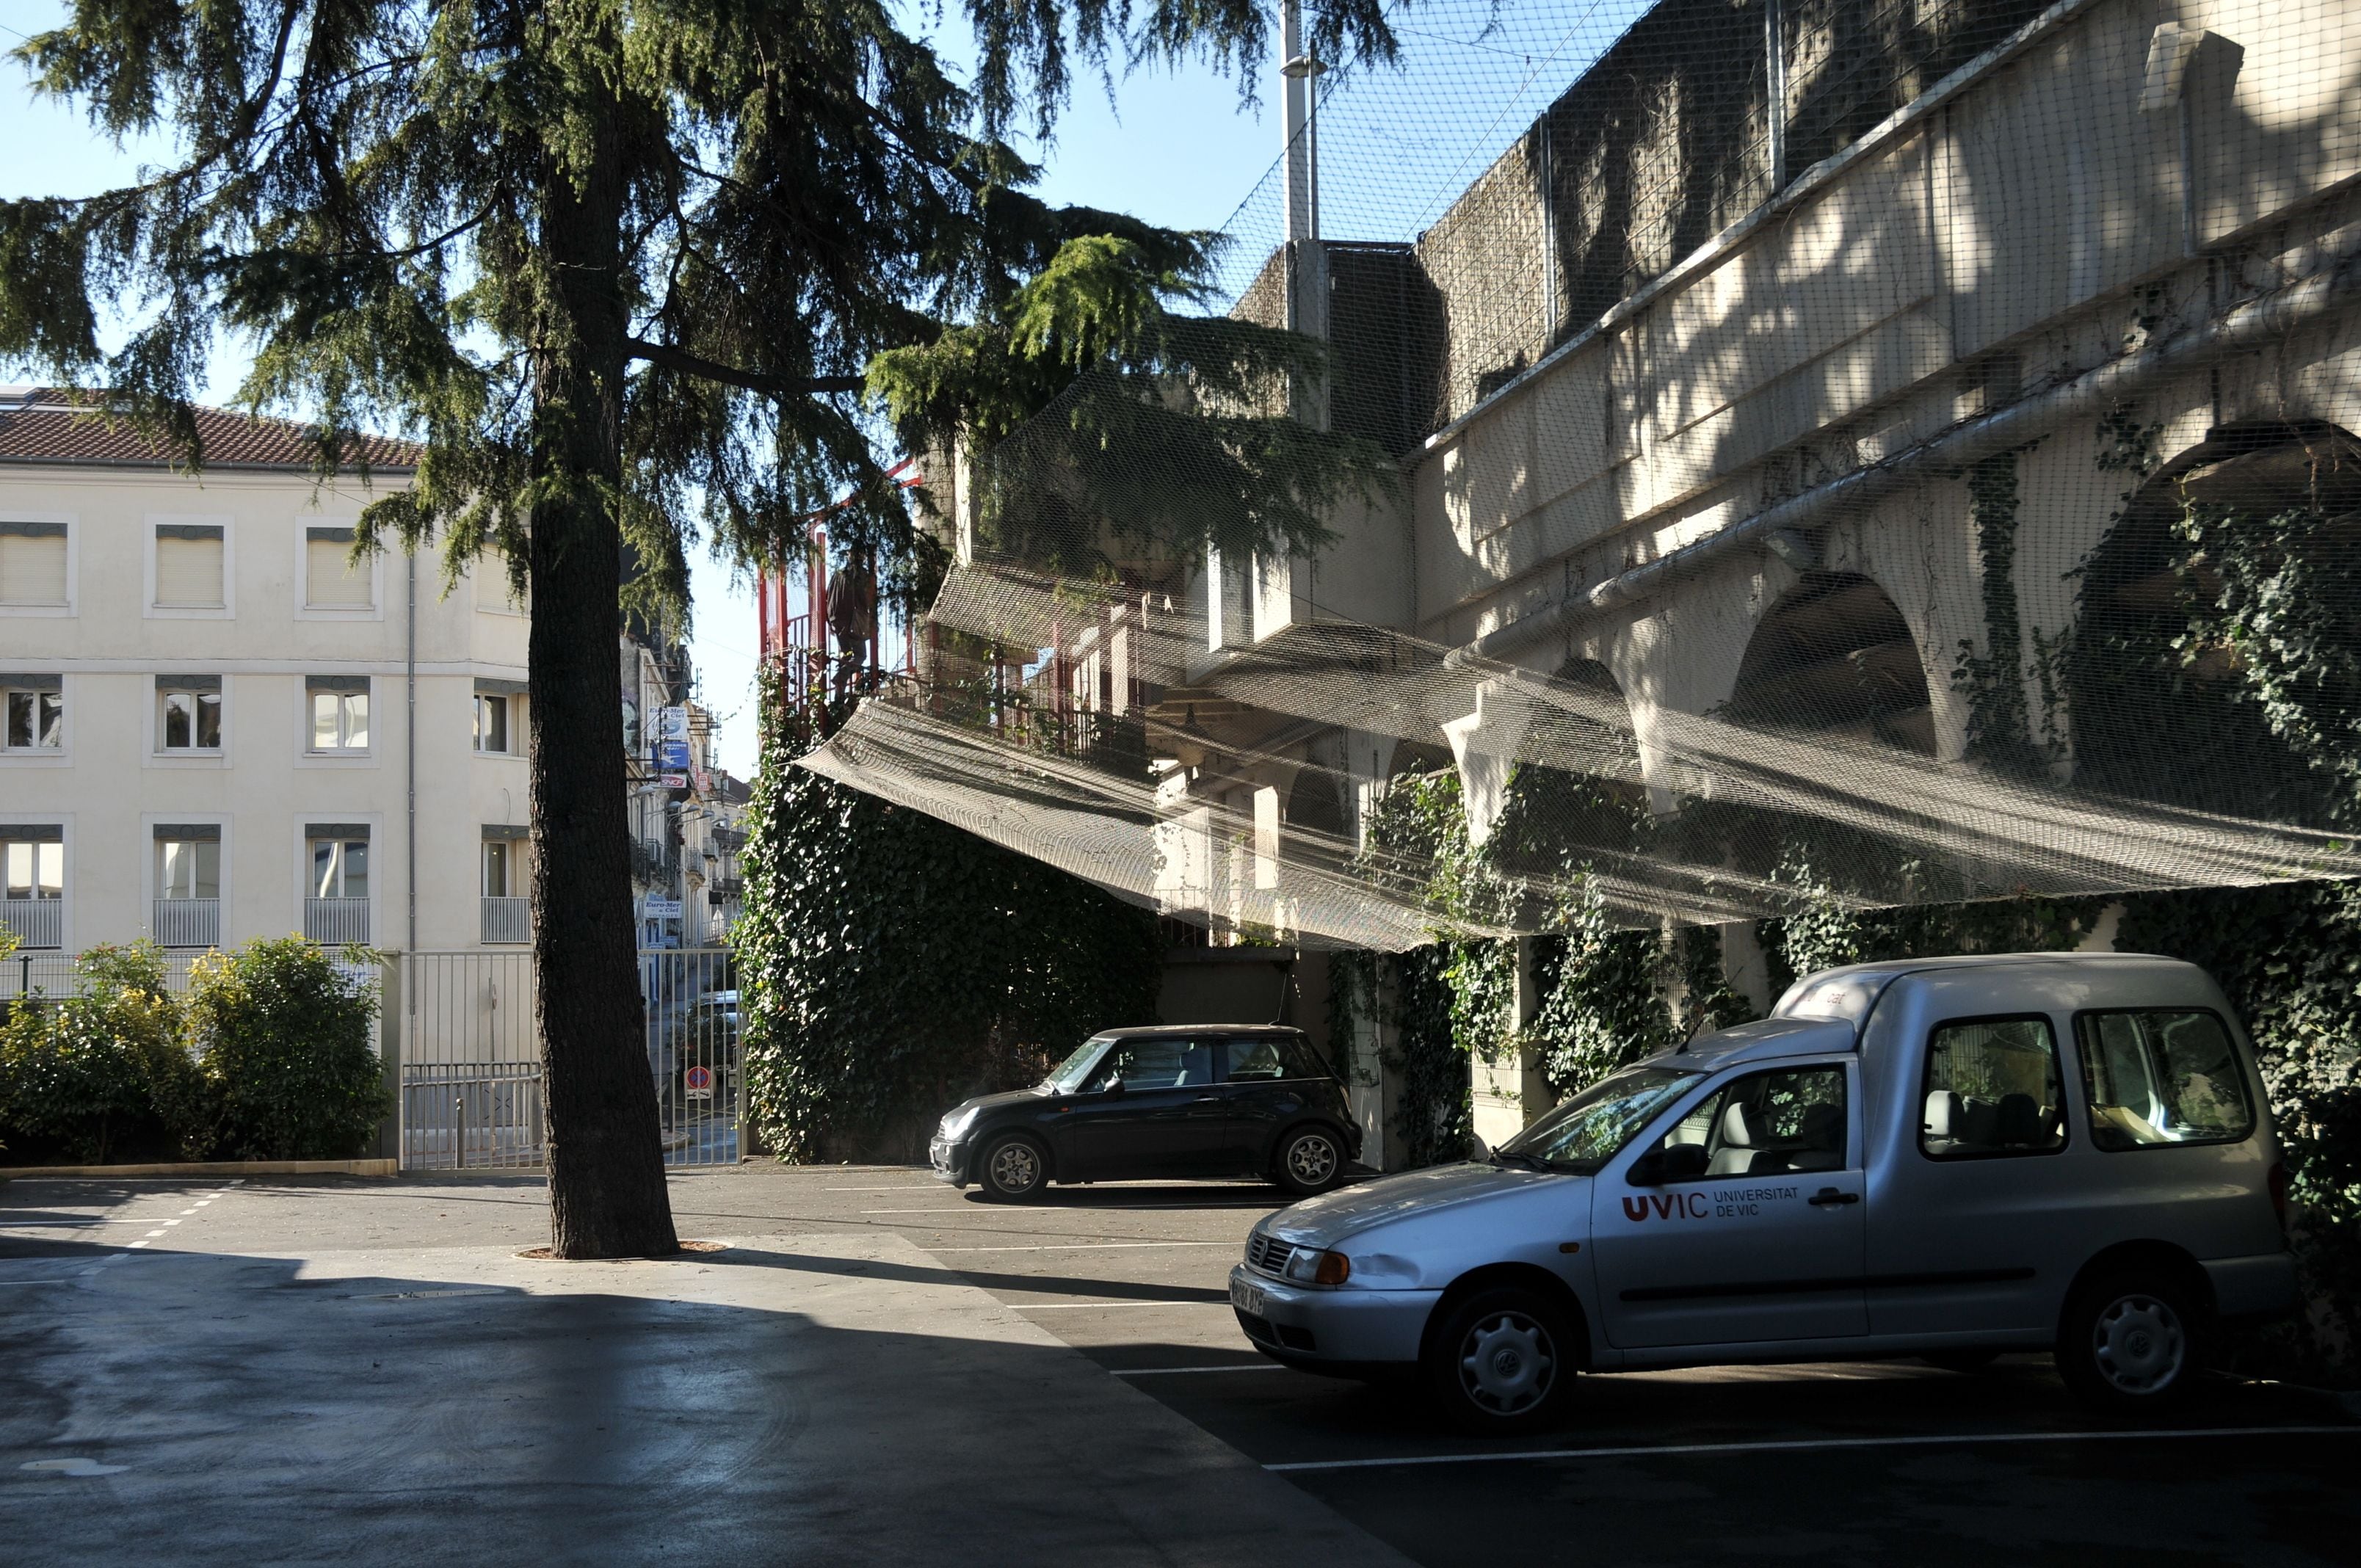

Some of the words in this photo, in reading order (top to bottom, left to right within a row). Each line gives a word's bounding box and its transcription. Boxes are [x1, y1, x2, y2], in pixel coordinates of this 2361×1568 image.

[1713, 1187, 1798, 1202] UNIVERSITAT
[1622, 1192, 1708, 1222] UVIC
[1716, 1205, 1734, 1217] DE
[1736, 1204, 1759, 1216] VIC
